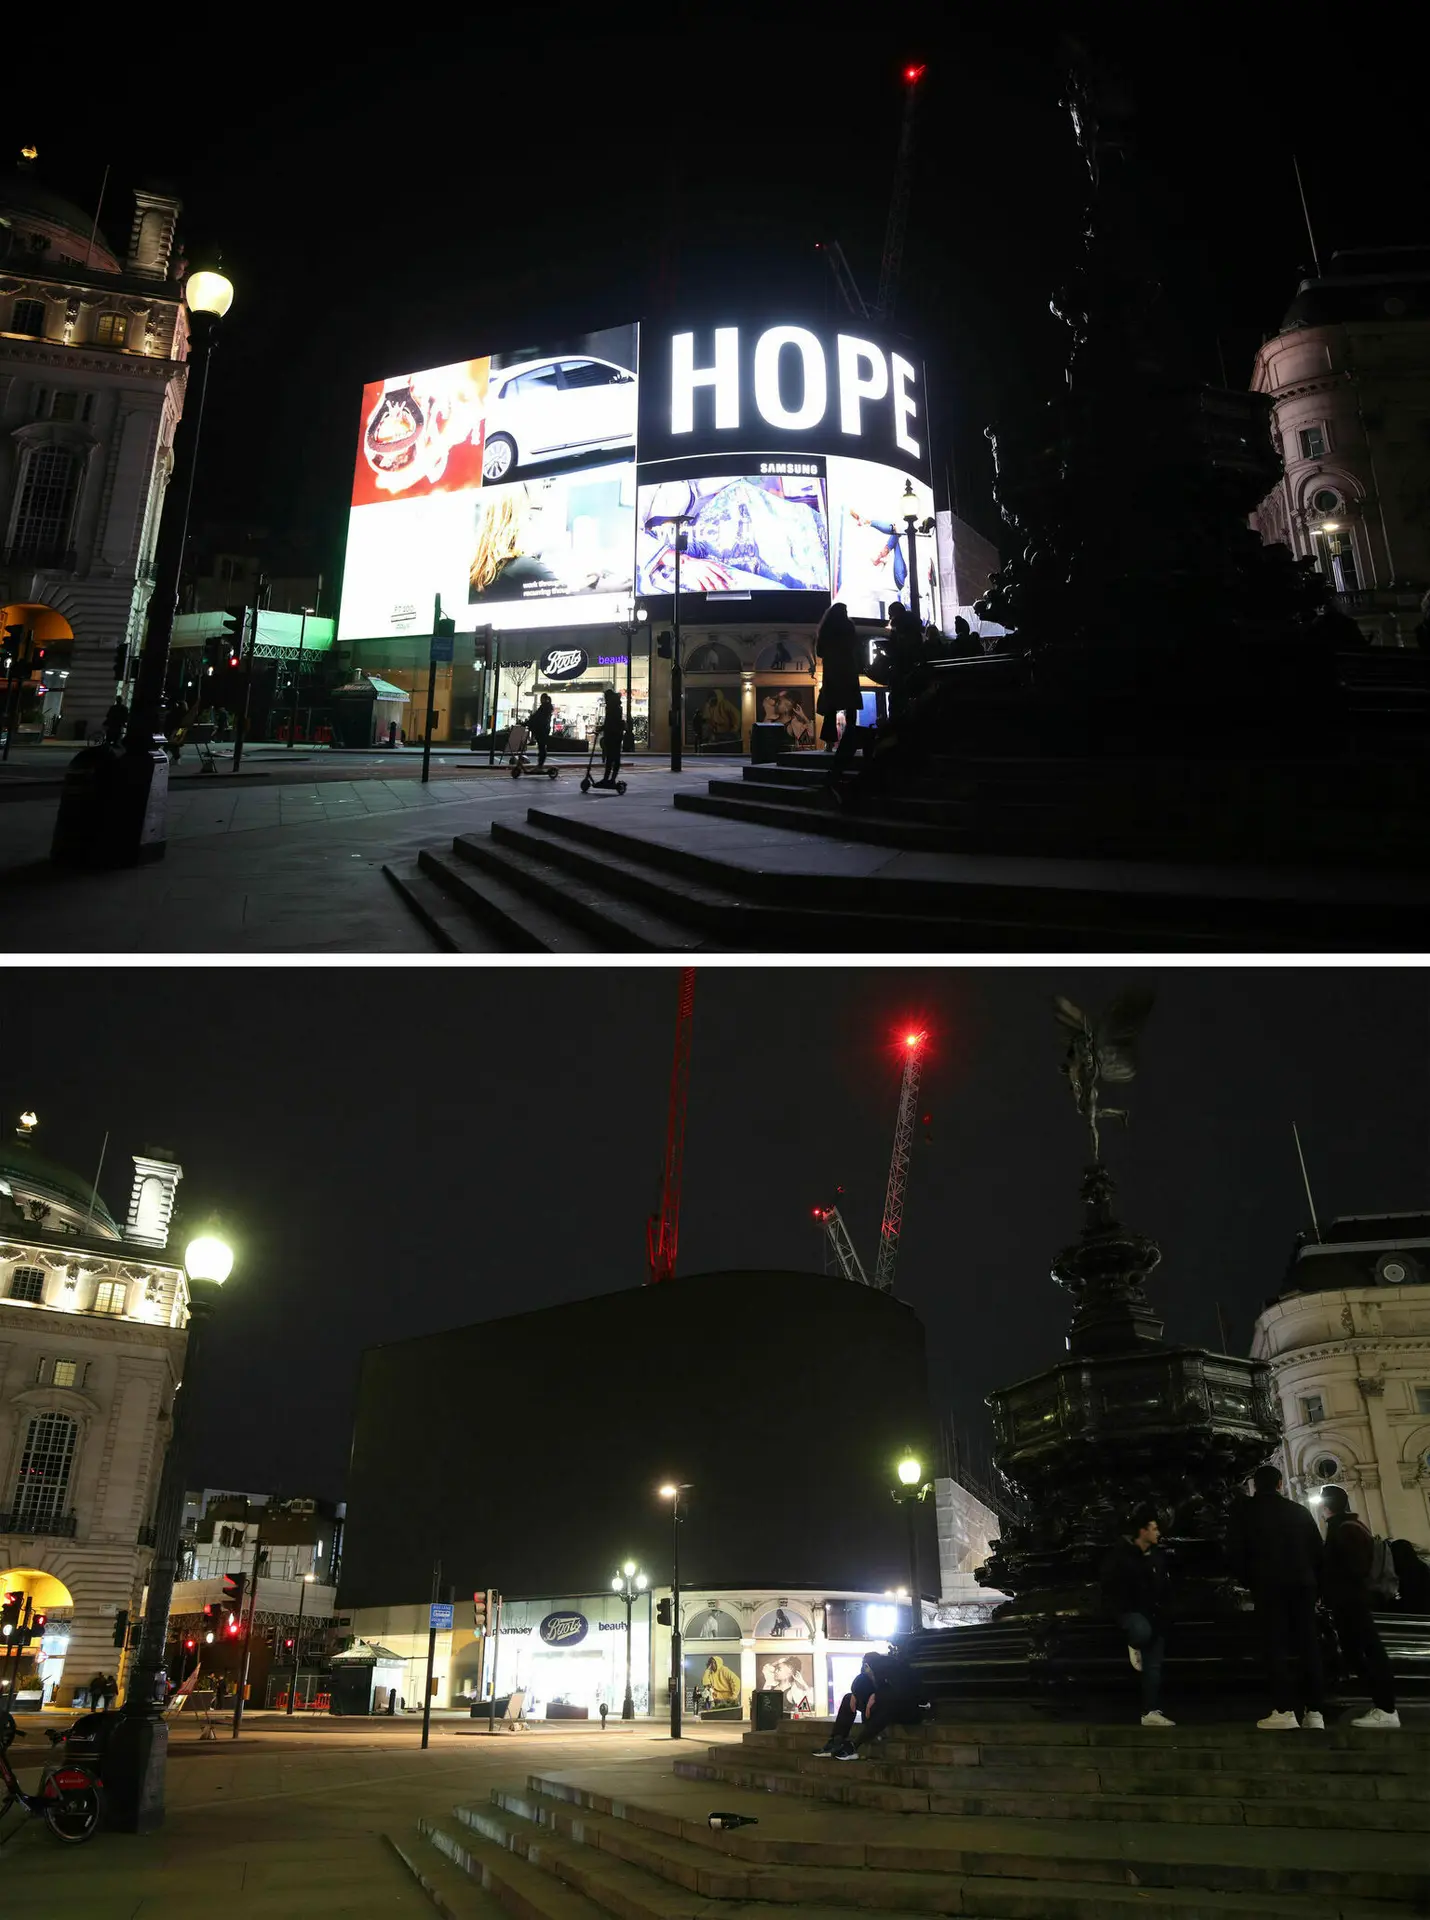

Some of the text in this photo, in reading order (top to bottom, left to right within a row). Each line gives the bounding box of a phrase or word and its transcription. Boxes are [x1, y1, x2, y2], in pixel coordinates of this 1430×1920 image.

[671, 326, 920, 459] HOPE
[760, 463, 818, 475] SAMSUNG
[544, 650, 582, 675] Boots
[598, 655, 628, 666] beauty
[544, 1617, 581, 1641] Boots
[598, 1621, 629, 1632] beauty
